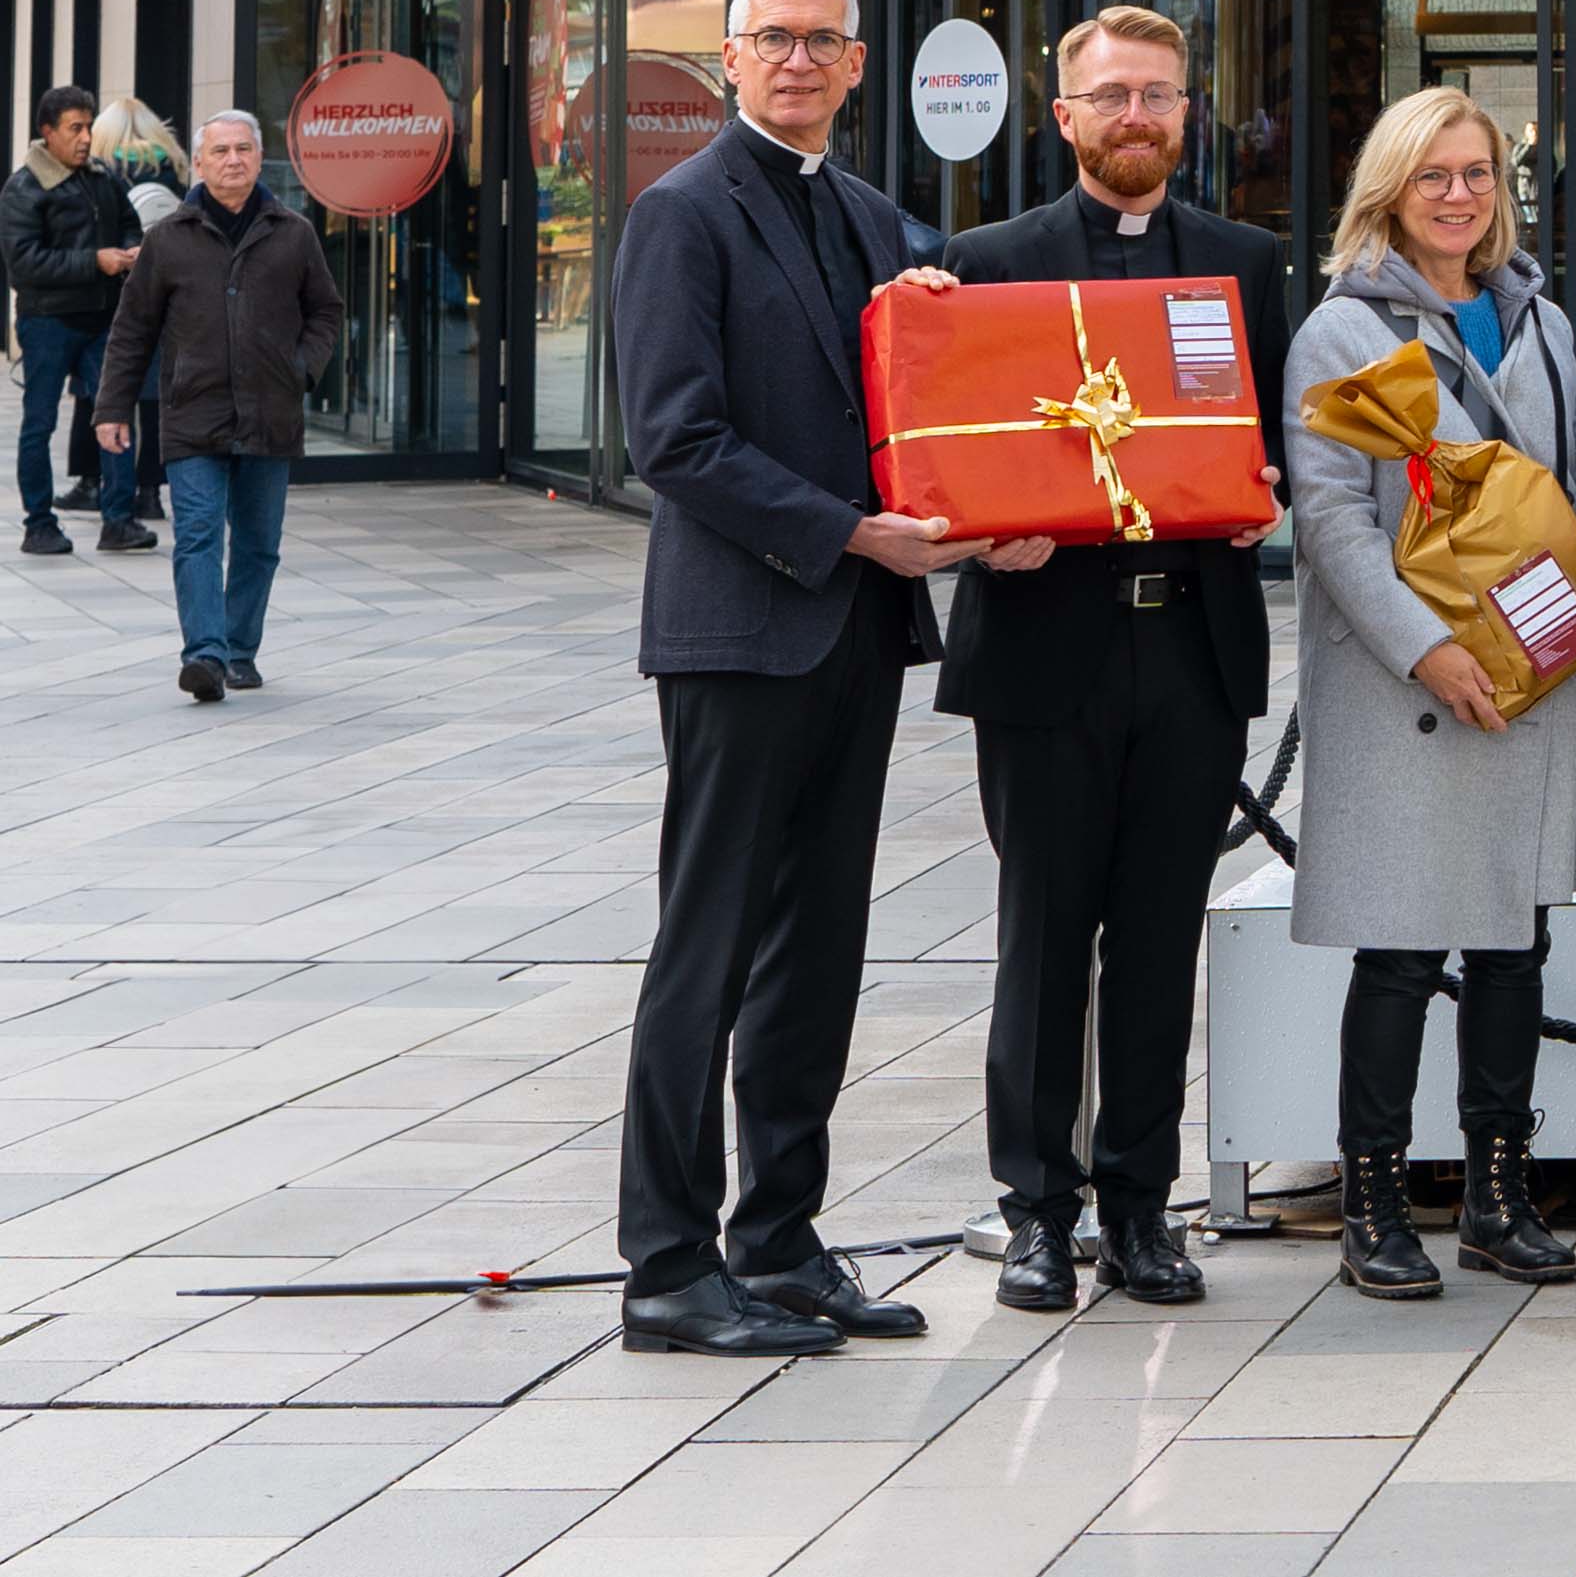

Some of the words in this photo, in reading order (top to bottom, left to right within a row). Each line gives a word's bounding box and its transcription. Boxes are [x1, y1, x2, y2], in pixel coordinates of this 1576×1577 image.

[929, 73, 1000, 89] INTERSPORT
[313, 103, 414, 120] HERZLICH
[926, 101, 949, 114] HIER
[951, 101, 963, 114] IM
[965, 101, 974, 113] 1.
[976, 100, 991, 113] OG
[302, 115, 443, 137] WILLKOMMEN
[303, 151, 319, 160] Mo
[337, 150, 351, 160] Sa
[414, 148, 432, 159] Uhr
